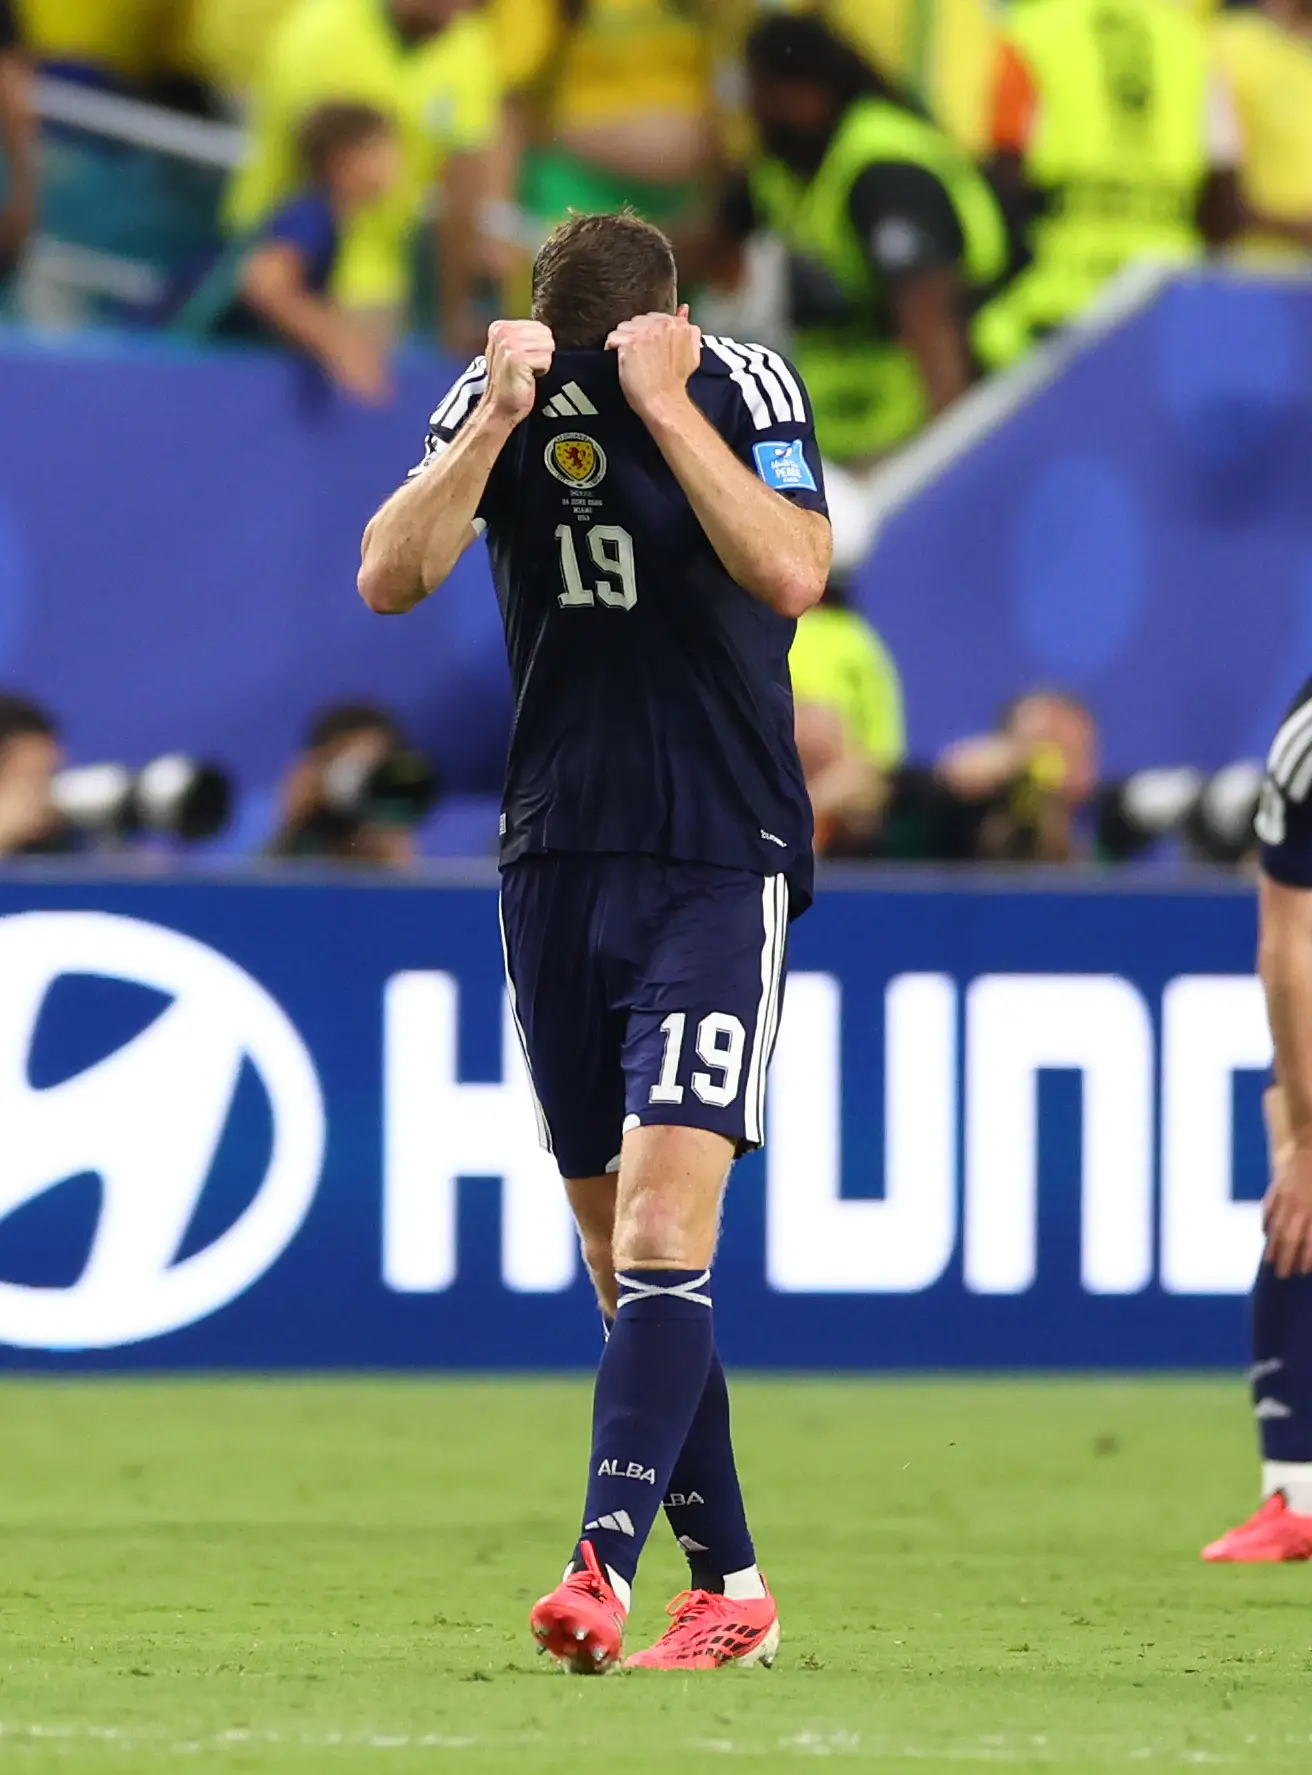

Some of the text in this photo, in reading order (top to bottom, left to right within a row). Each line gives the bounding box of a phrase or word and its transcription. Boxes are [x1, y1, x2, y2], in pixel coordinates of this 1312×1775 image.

[553, 523, 638, 612] 19
[648, 1011, 746, 1108] 19
[597, 1458, 656, 1485] ALBA
